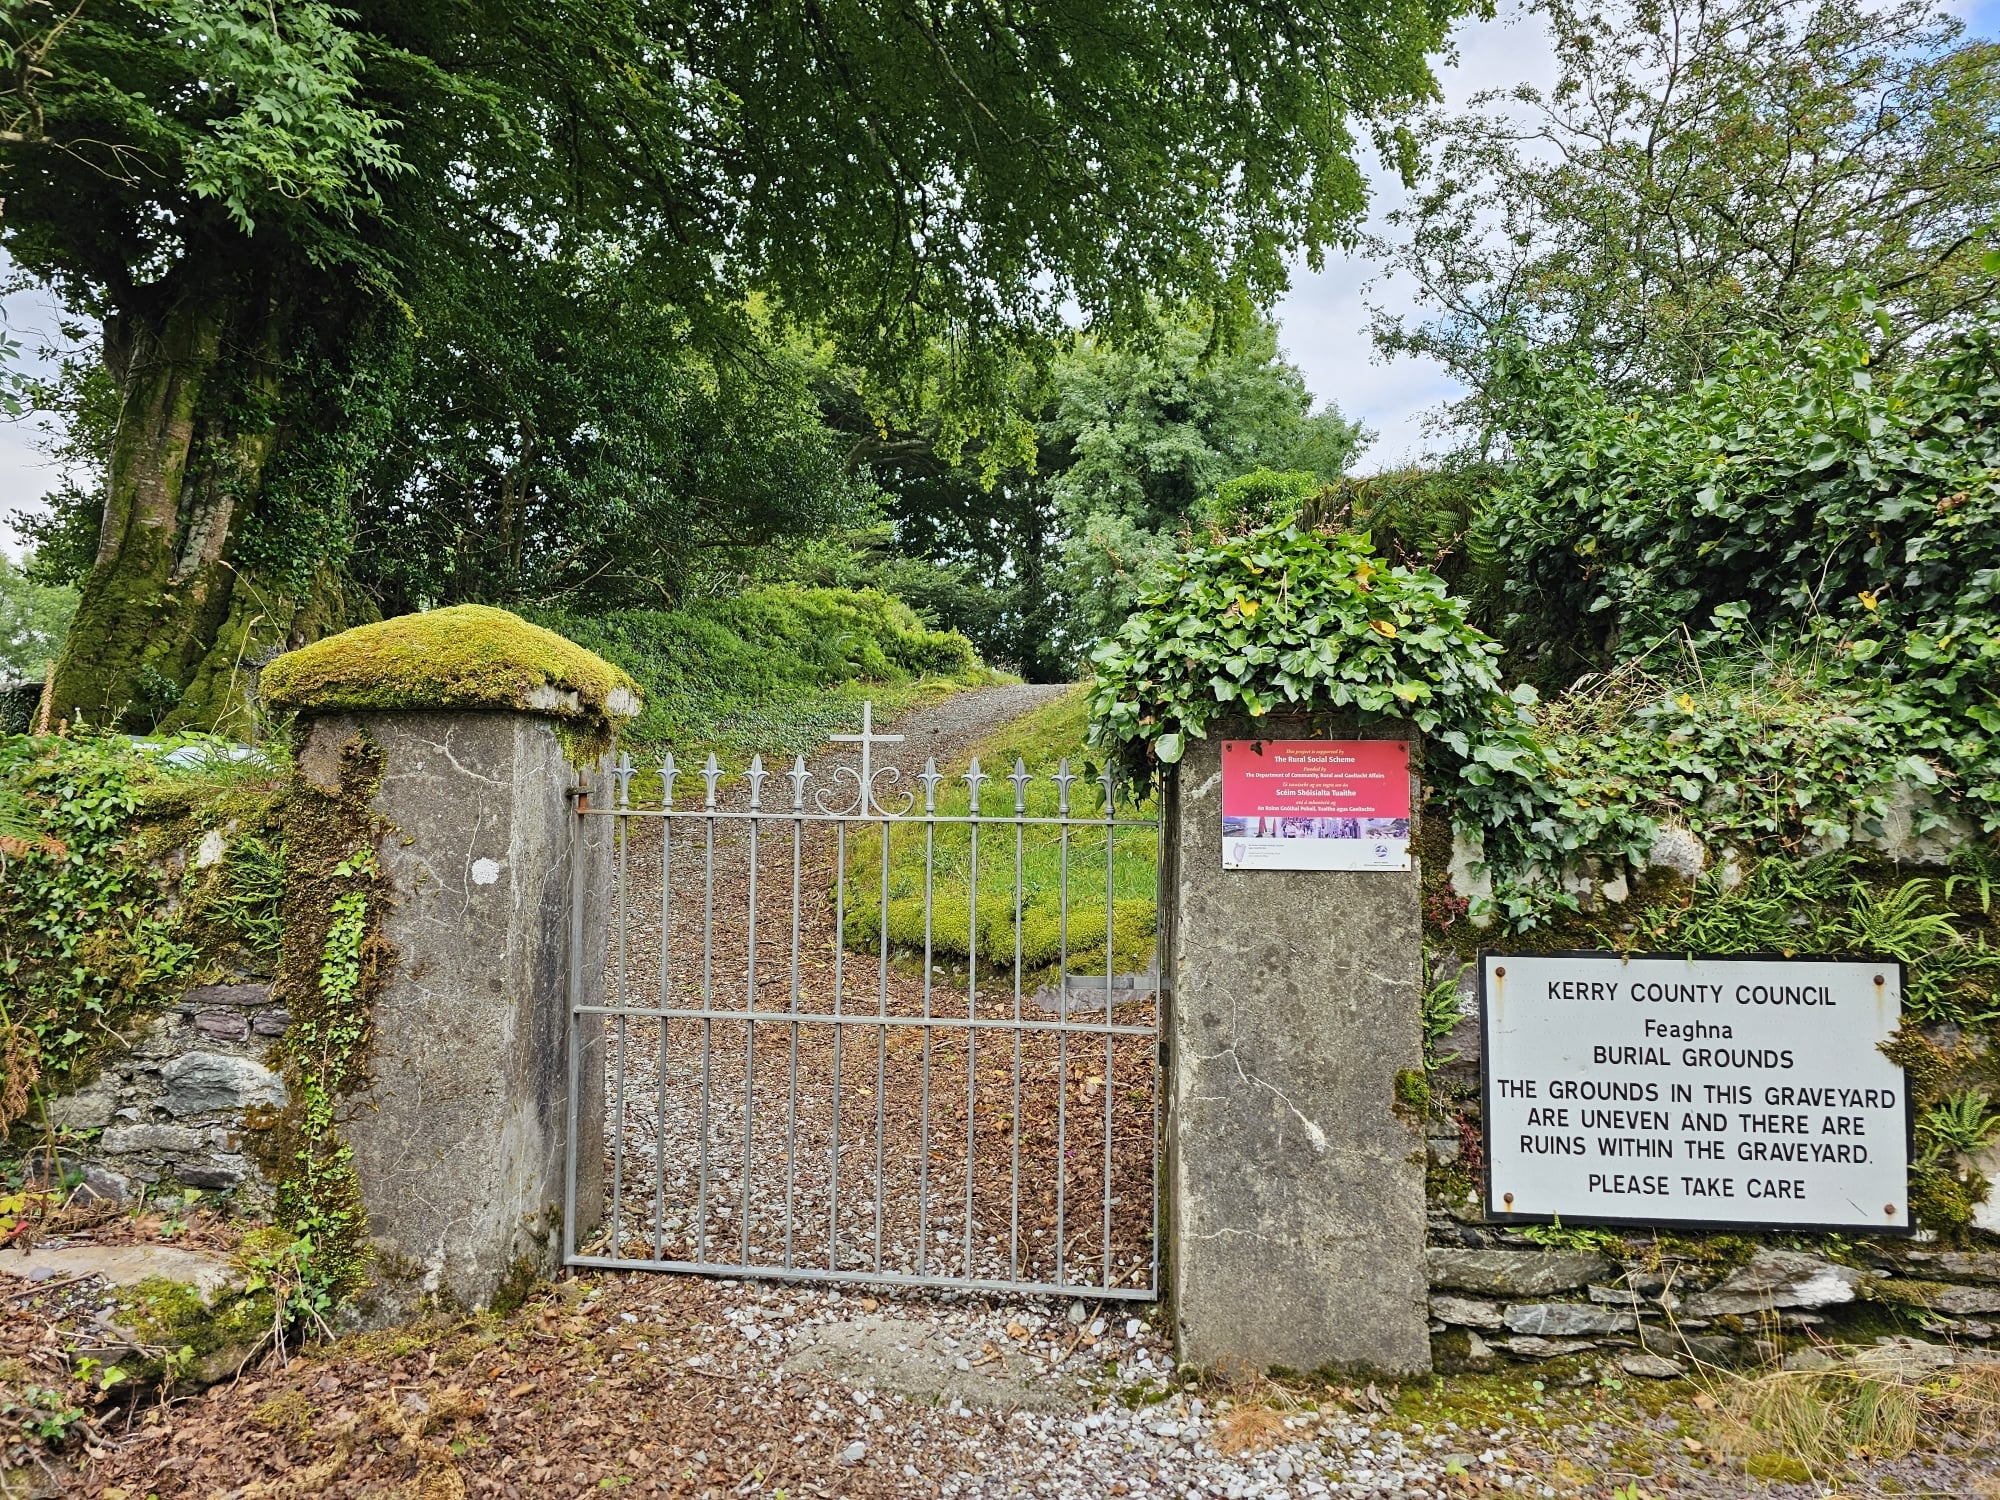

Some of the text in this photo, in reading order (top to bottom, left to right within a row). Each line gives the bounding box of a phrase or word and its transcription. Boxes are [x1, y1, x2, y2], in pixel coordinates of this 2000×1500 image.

[1549, 982, 1836, 1006] KERRY COUNTY COUNCIL
[1646, 1019, 1733, 1042] Feaghna
[1594, 1046, 1794, 1069] BURIAL GROUNDS
[1498, 1080, 1895, 1109] THE GROUNDS IN THIS GRAVEYARD
[1528, 1108, 1865, 1135] ARE UNEVEN AND THERE ARE
[1521, 1135, 1873, 1164] RUINS WITHIN THE GRAVEYARD.
[1589, 1174, 1805, 1199] PLEASE TAKE CARE
